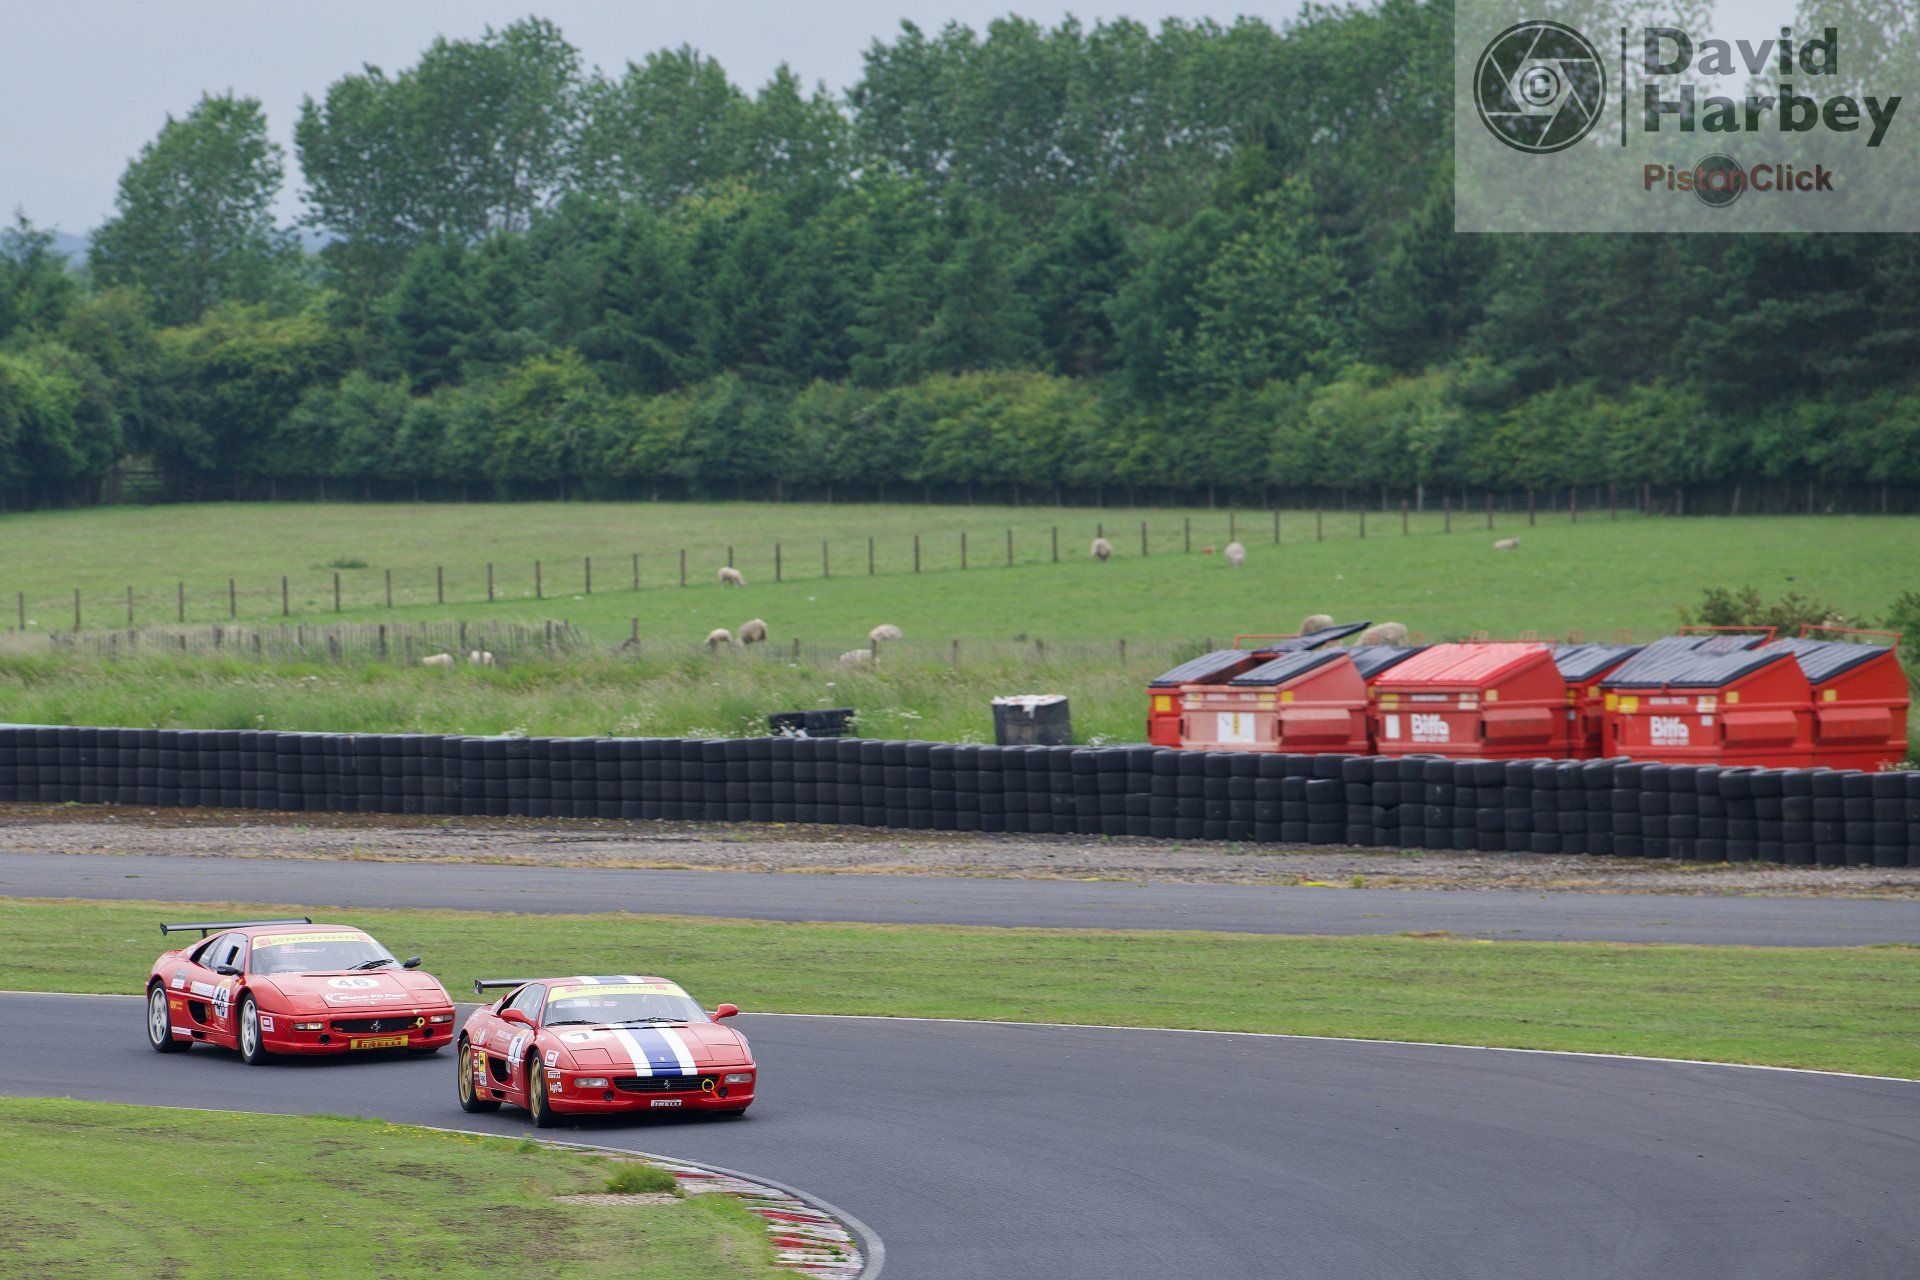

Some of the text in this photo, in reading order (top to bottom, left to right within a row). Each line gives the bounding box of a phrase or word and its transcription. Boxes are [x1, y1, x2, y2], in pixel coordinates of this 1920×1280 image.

[1650, 716, 1690, 737] Biffa
[338, 979, 370, 987] 46
[215, 987, 228, 1017] 46
[356, 1037, 403, 1049] PIRELLI
